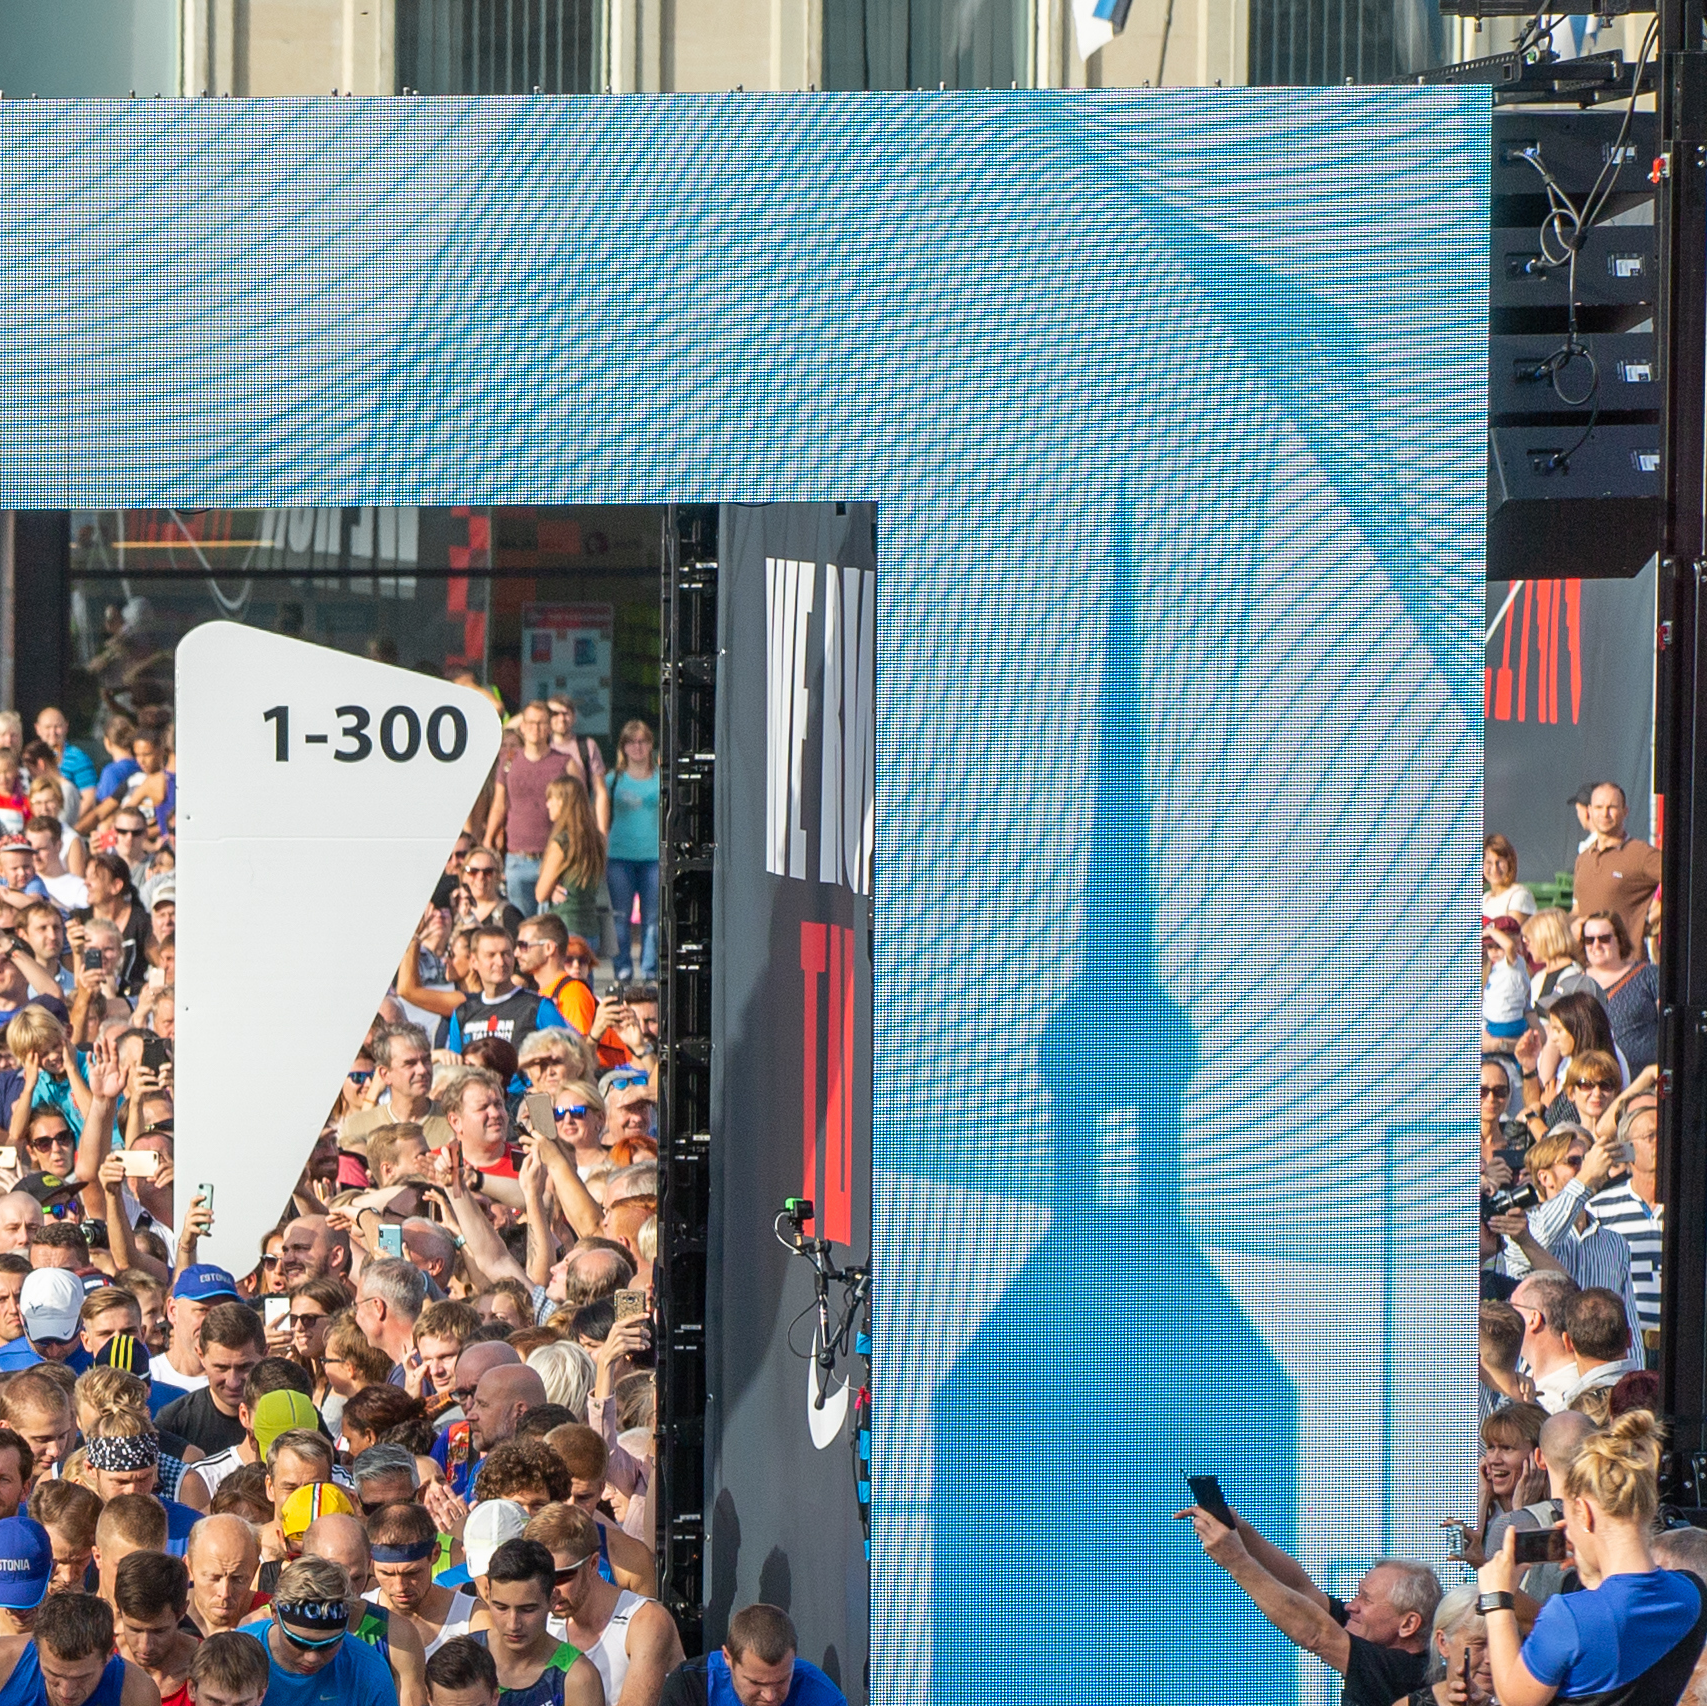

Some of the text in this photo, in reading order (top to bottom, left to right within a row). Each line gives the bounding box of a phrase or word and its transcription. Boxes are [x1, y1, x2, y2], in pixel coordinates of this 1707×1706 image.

[263, 705, 467, 763] 1-300
[765, 557, 875, 896] WE RU
